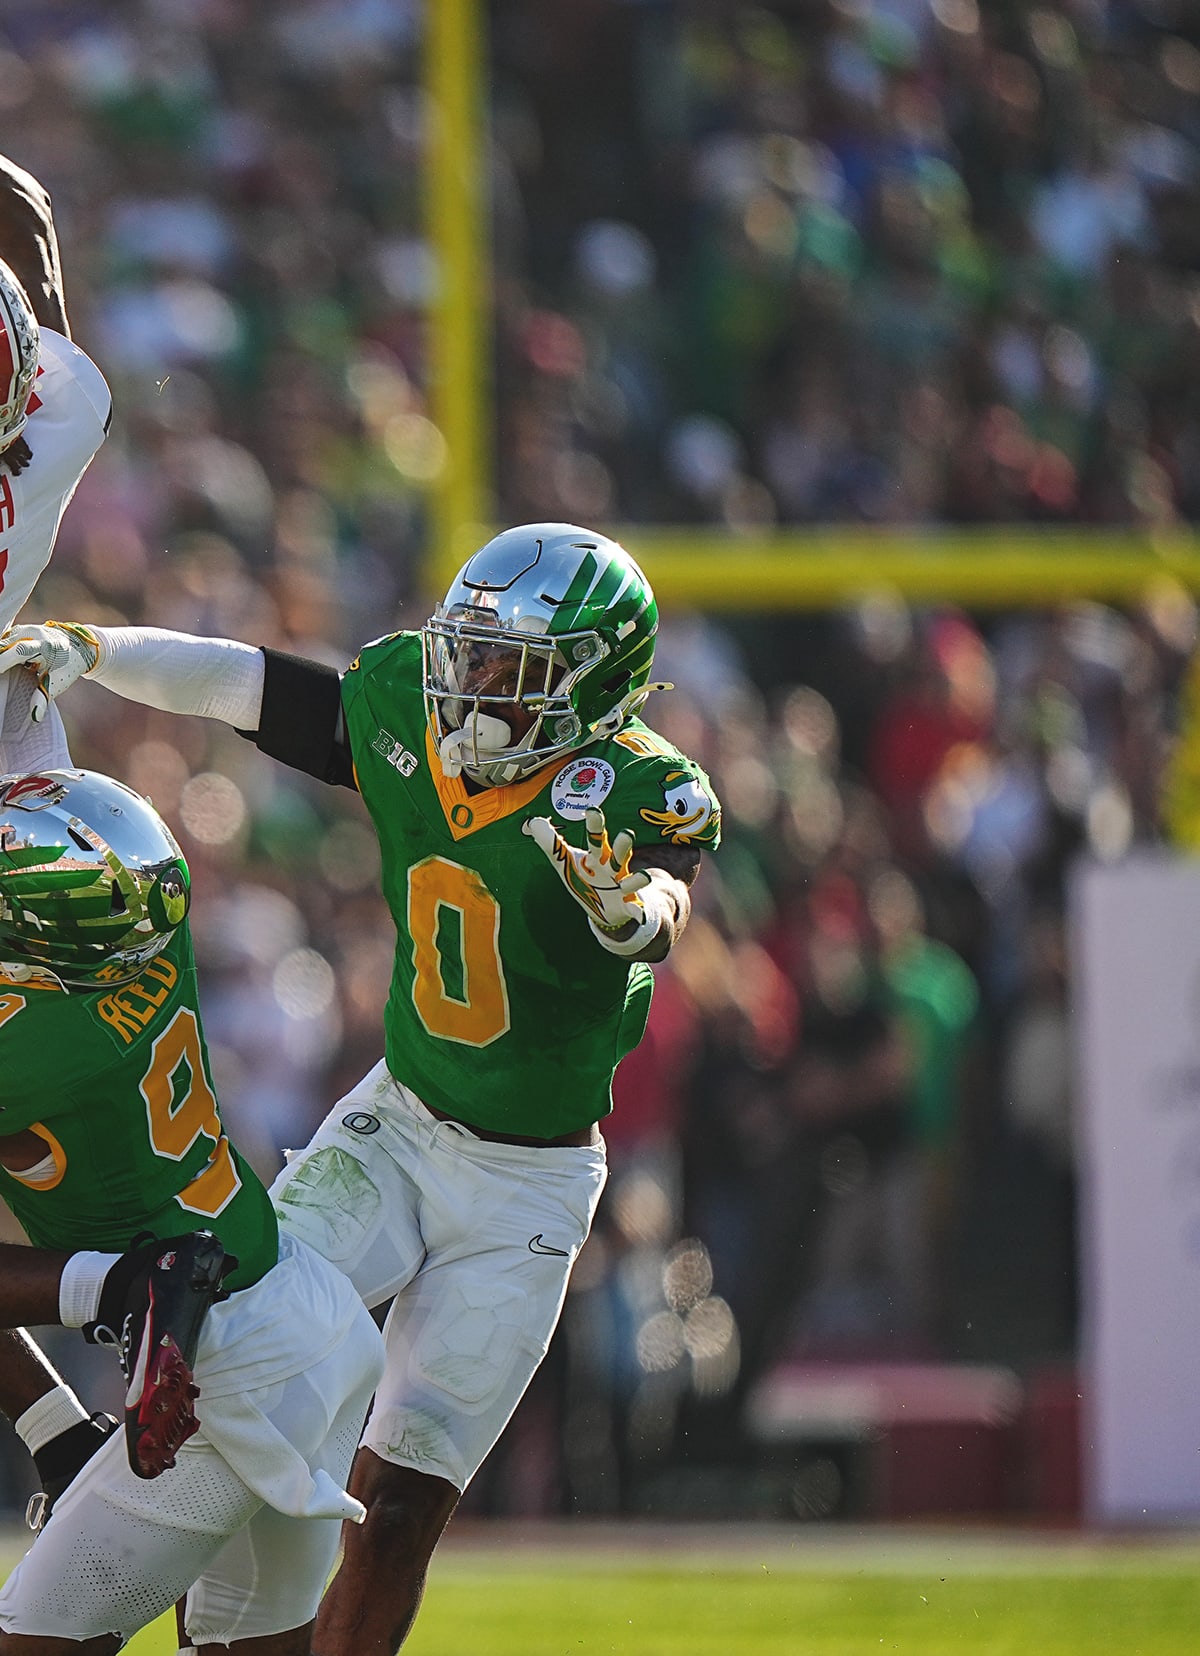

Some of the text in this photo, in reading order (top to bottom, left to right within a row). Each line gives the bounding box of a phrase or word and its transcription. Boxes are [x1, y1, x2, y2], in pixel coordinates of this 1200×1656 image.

[555, 760, 611, 793] ROSE BOWL GAME
[97, 956, 178, 1044] REED
[407, 854, 511, 1048] 0
[139, 1005, 243, 1219] 9
